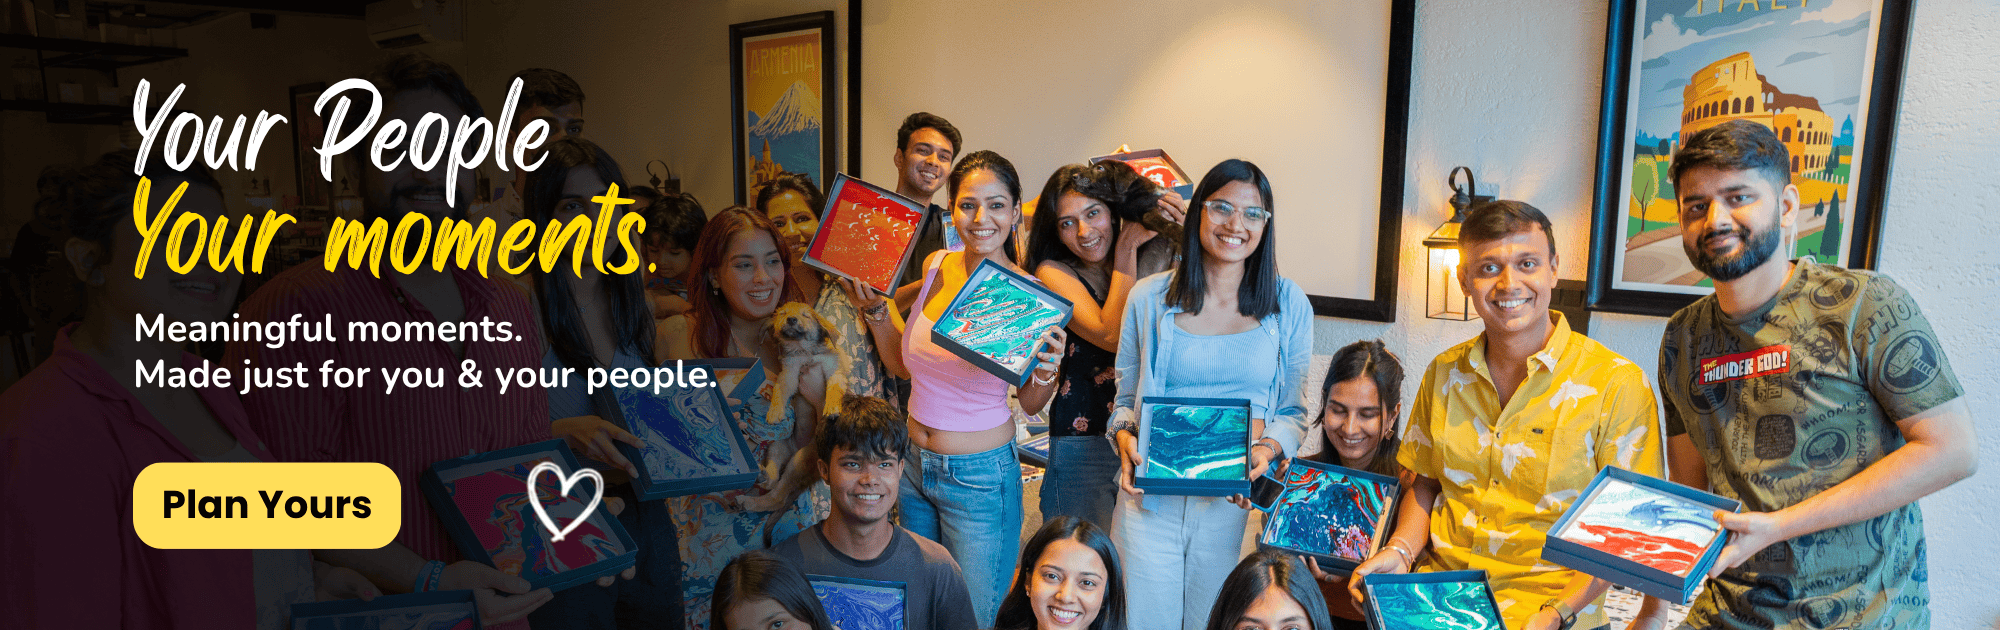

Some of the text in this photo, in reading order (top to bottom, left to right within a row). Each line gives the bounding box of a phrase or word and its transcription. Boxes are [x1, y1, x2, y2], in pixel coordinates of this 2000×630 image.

[751, 42, 815, 77] ARMENIA
[1703, 359, 1718, 372] THE
[1703, 350, 1788, 383] THUNDER GOD!
